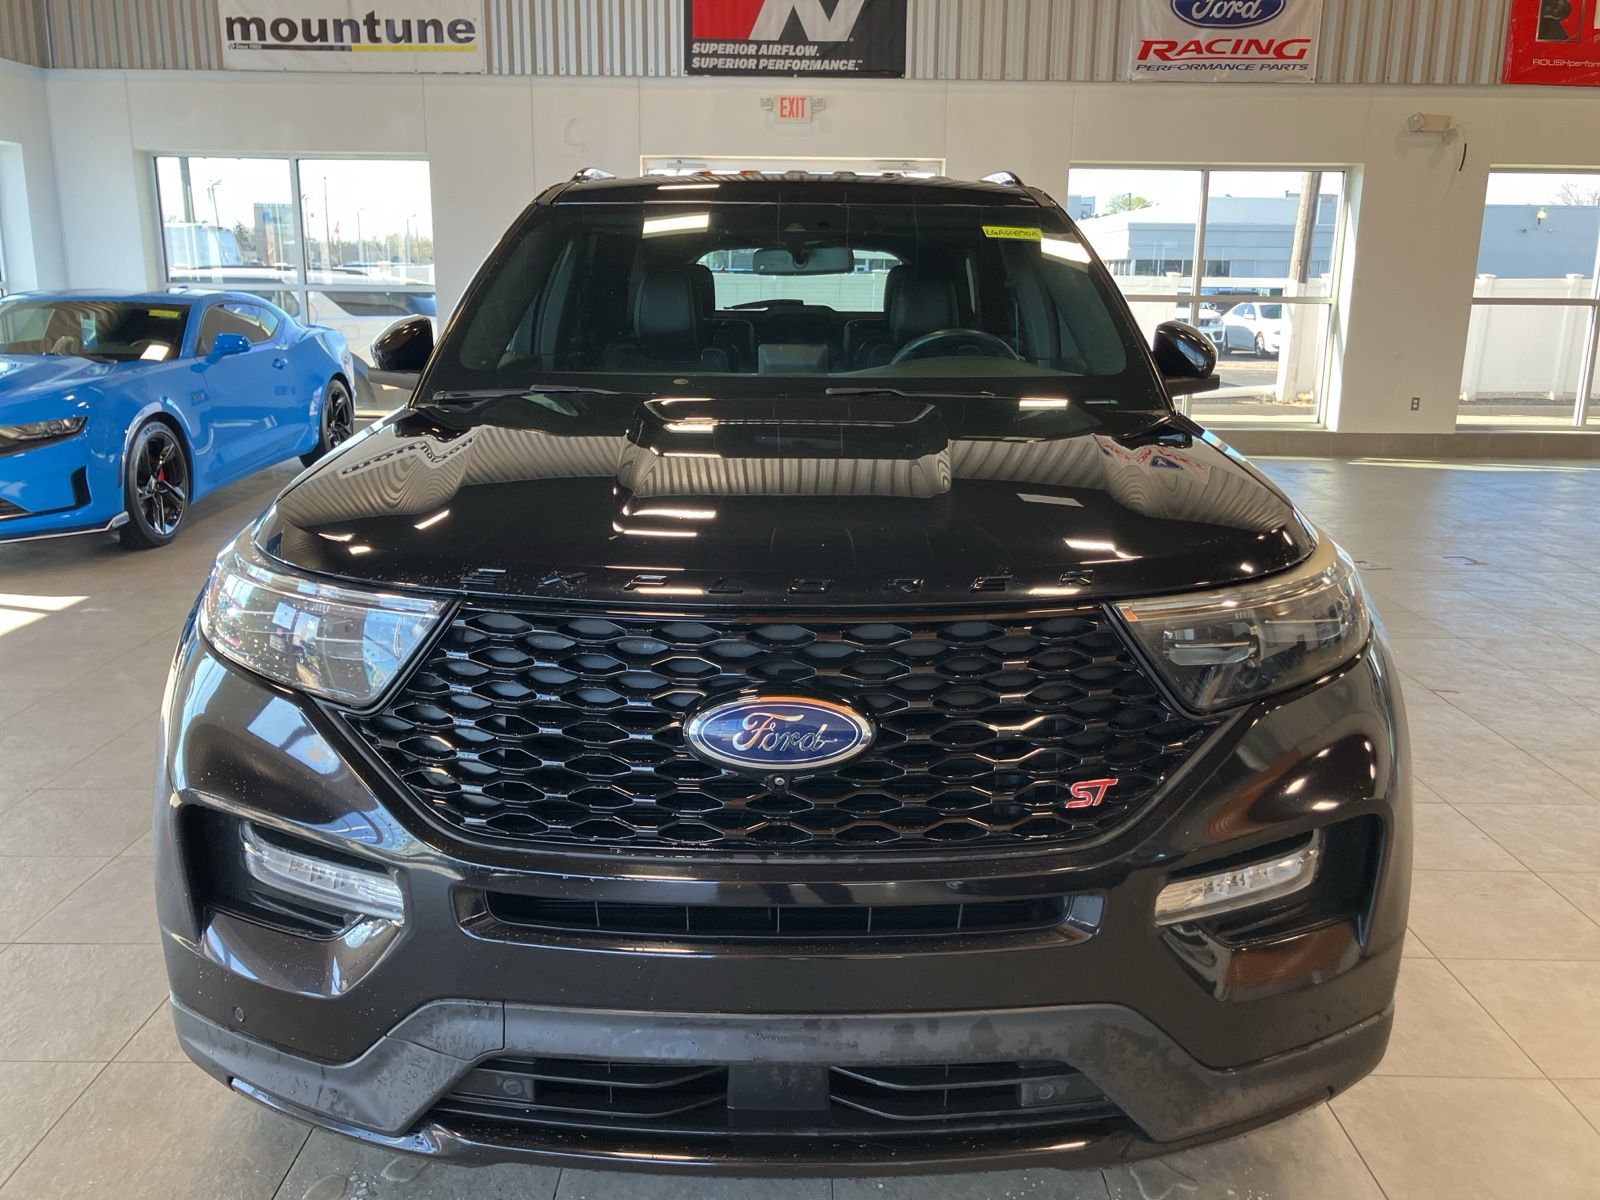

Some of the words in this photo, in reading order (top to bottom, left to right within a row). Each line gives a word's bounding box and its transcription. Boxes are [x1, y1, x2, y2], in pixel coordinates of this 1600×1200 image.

[225, 10, 476, 43] mountune
[691, 42, 757, 55] SUPERIOR
[758, 44, 820, 57] AIRFLOW.
[1137, 38, 1312, 61] RACING
[691, 57, 757, 70] SUPERIOR
[1136, 63, 1255, 71] PERFORMANCE
[1259, 63, 1310, 71] PARTS
[779, 96, 807, 118] EXIT
[732, 712, 838, 752] Ford
[1065, 778, 1119, 809] ST
